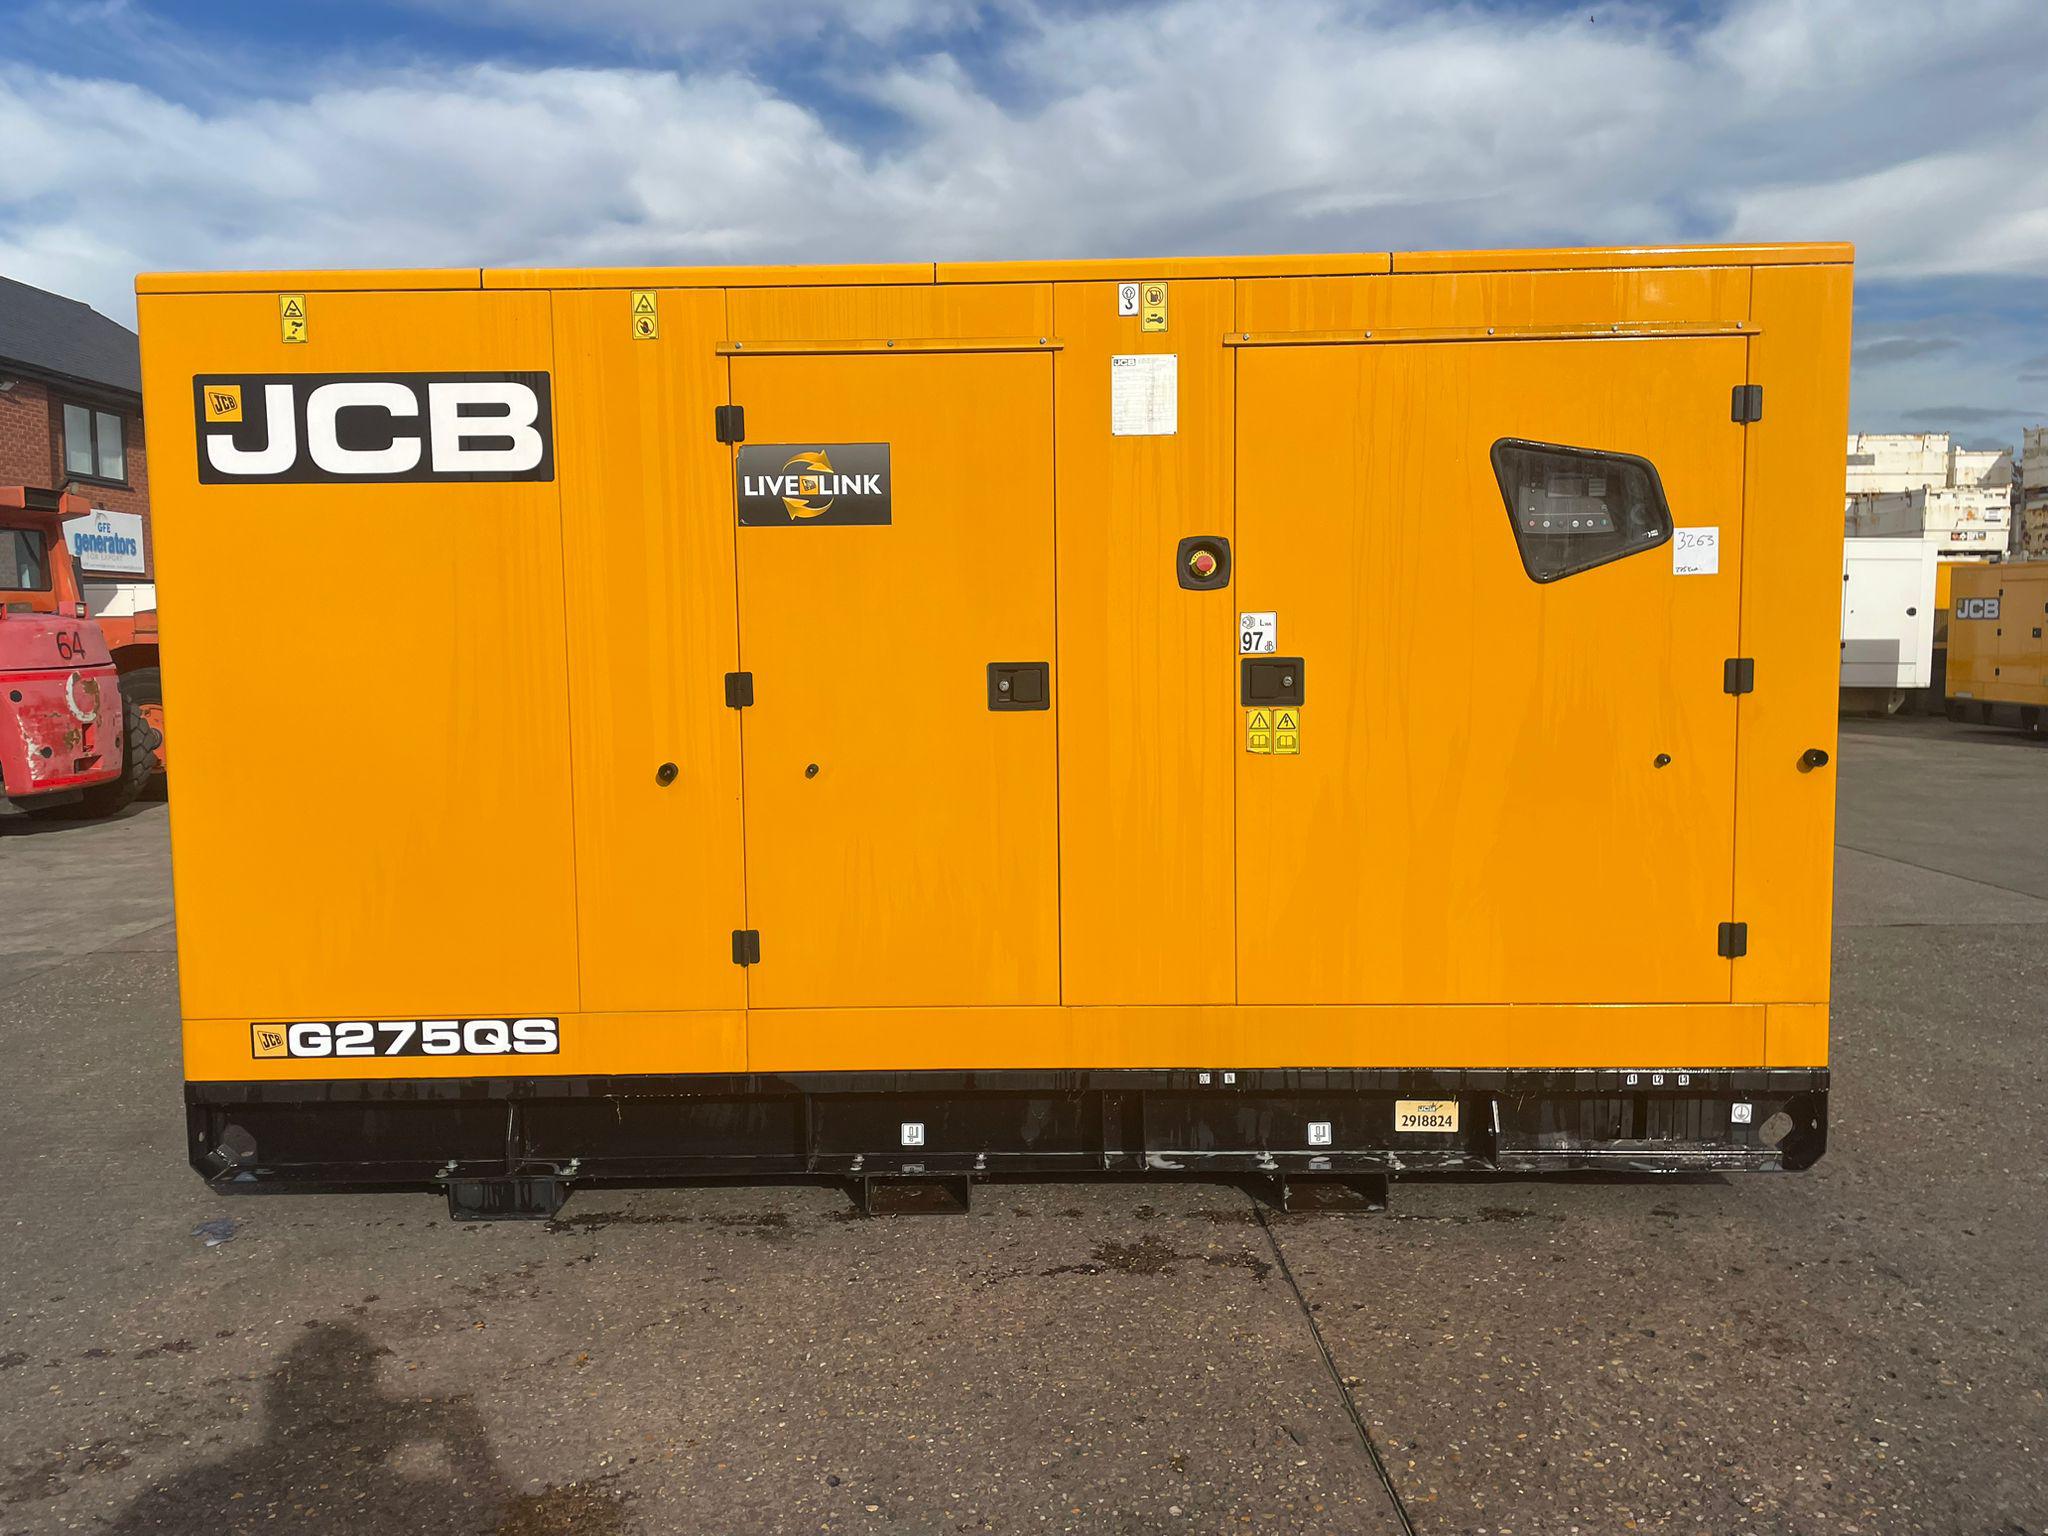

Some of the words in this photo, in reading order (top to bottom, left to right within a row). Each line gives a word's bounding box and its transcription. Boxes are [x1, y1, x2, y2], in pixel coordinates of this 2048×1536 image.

[213, 392, 238, 415] JCB
[206, 382, 544, 475] JCB
[743, 475, 799, 496] LIVE
[818, 474, 882, 496] LINK
[97, 522, 111, 533] GFE
[74, 532, 137, 557] generators
[1677, 531, 1715, 550] 3263
[1957, 599, 1999, 619] JCB
[56, 631, 86, 661] 64
[1242, 631, 1263, 651] 97
[1264, 640, 1274, 652] dB
[262, 1032, 282, 1049] JCB
[287, 1018, 557, 1057] G275QS
[1654, 1075, 1662, 1085] L2
[1401, 1114, 1453, 1127] 2918824
